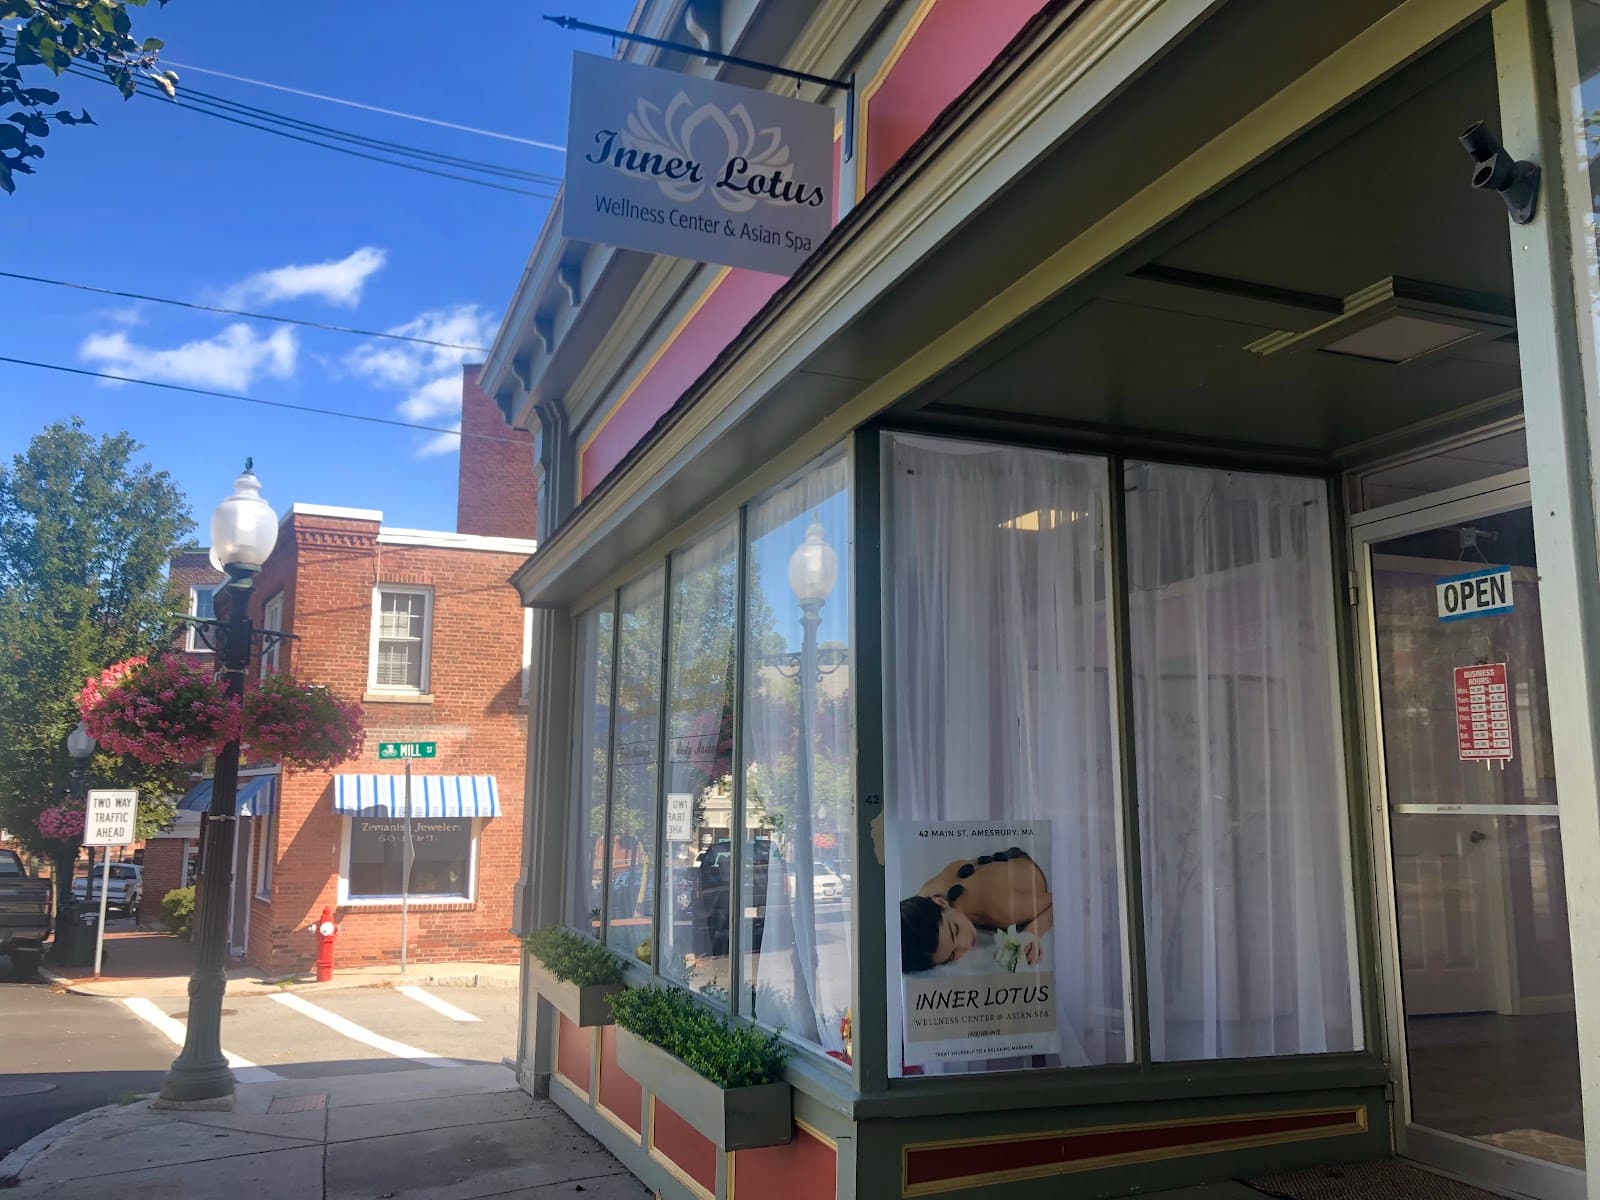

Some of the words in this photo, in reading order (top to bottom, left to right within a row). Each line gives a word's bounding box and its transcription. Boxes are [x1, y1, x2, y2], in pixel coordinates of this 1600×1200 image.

[585, 129, 704, 184] Inner
[716, 156, 825, 208] Lotus
[595, 194, 665, 225] Wellness
[669, 208, 720, 234] Center
[723, 219, 736, 238] &
[740, 222, 781, 247] Asian
[785, 230, 812, 253] Spa
[1443, 574, 1507, 614] OPEN
[400, 743, 422, 757] MILL
[93, 798, 111, 809] TWO
[115, 798, 133, 808] WAY
[865, 794, 880, 805] 42
[95, 812, 129, 823] TRAFFIC
[96, 826, 125, 838] AHEAD
[919, 830, 929, 838] 42
[931, 829, 954, 838] MAIN
[1022, 828, 1034, 836] MA
[916, 988, 979, 1011] INNER
[984, 985, 1049, 1006] LOTUS
[915, 1016, 959, 1027] WELLNESS
[961, 1014, 996, 1024] CENTER
[1006, 1011, 1032, 1020] ASIAN
[1034, 1010, 1049, 1018] SPA
